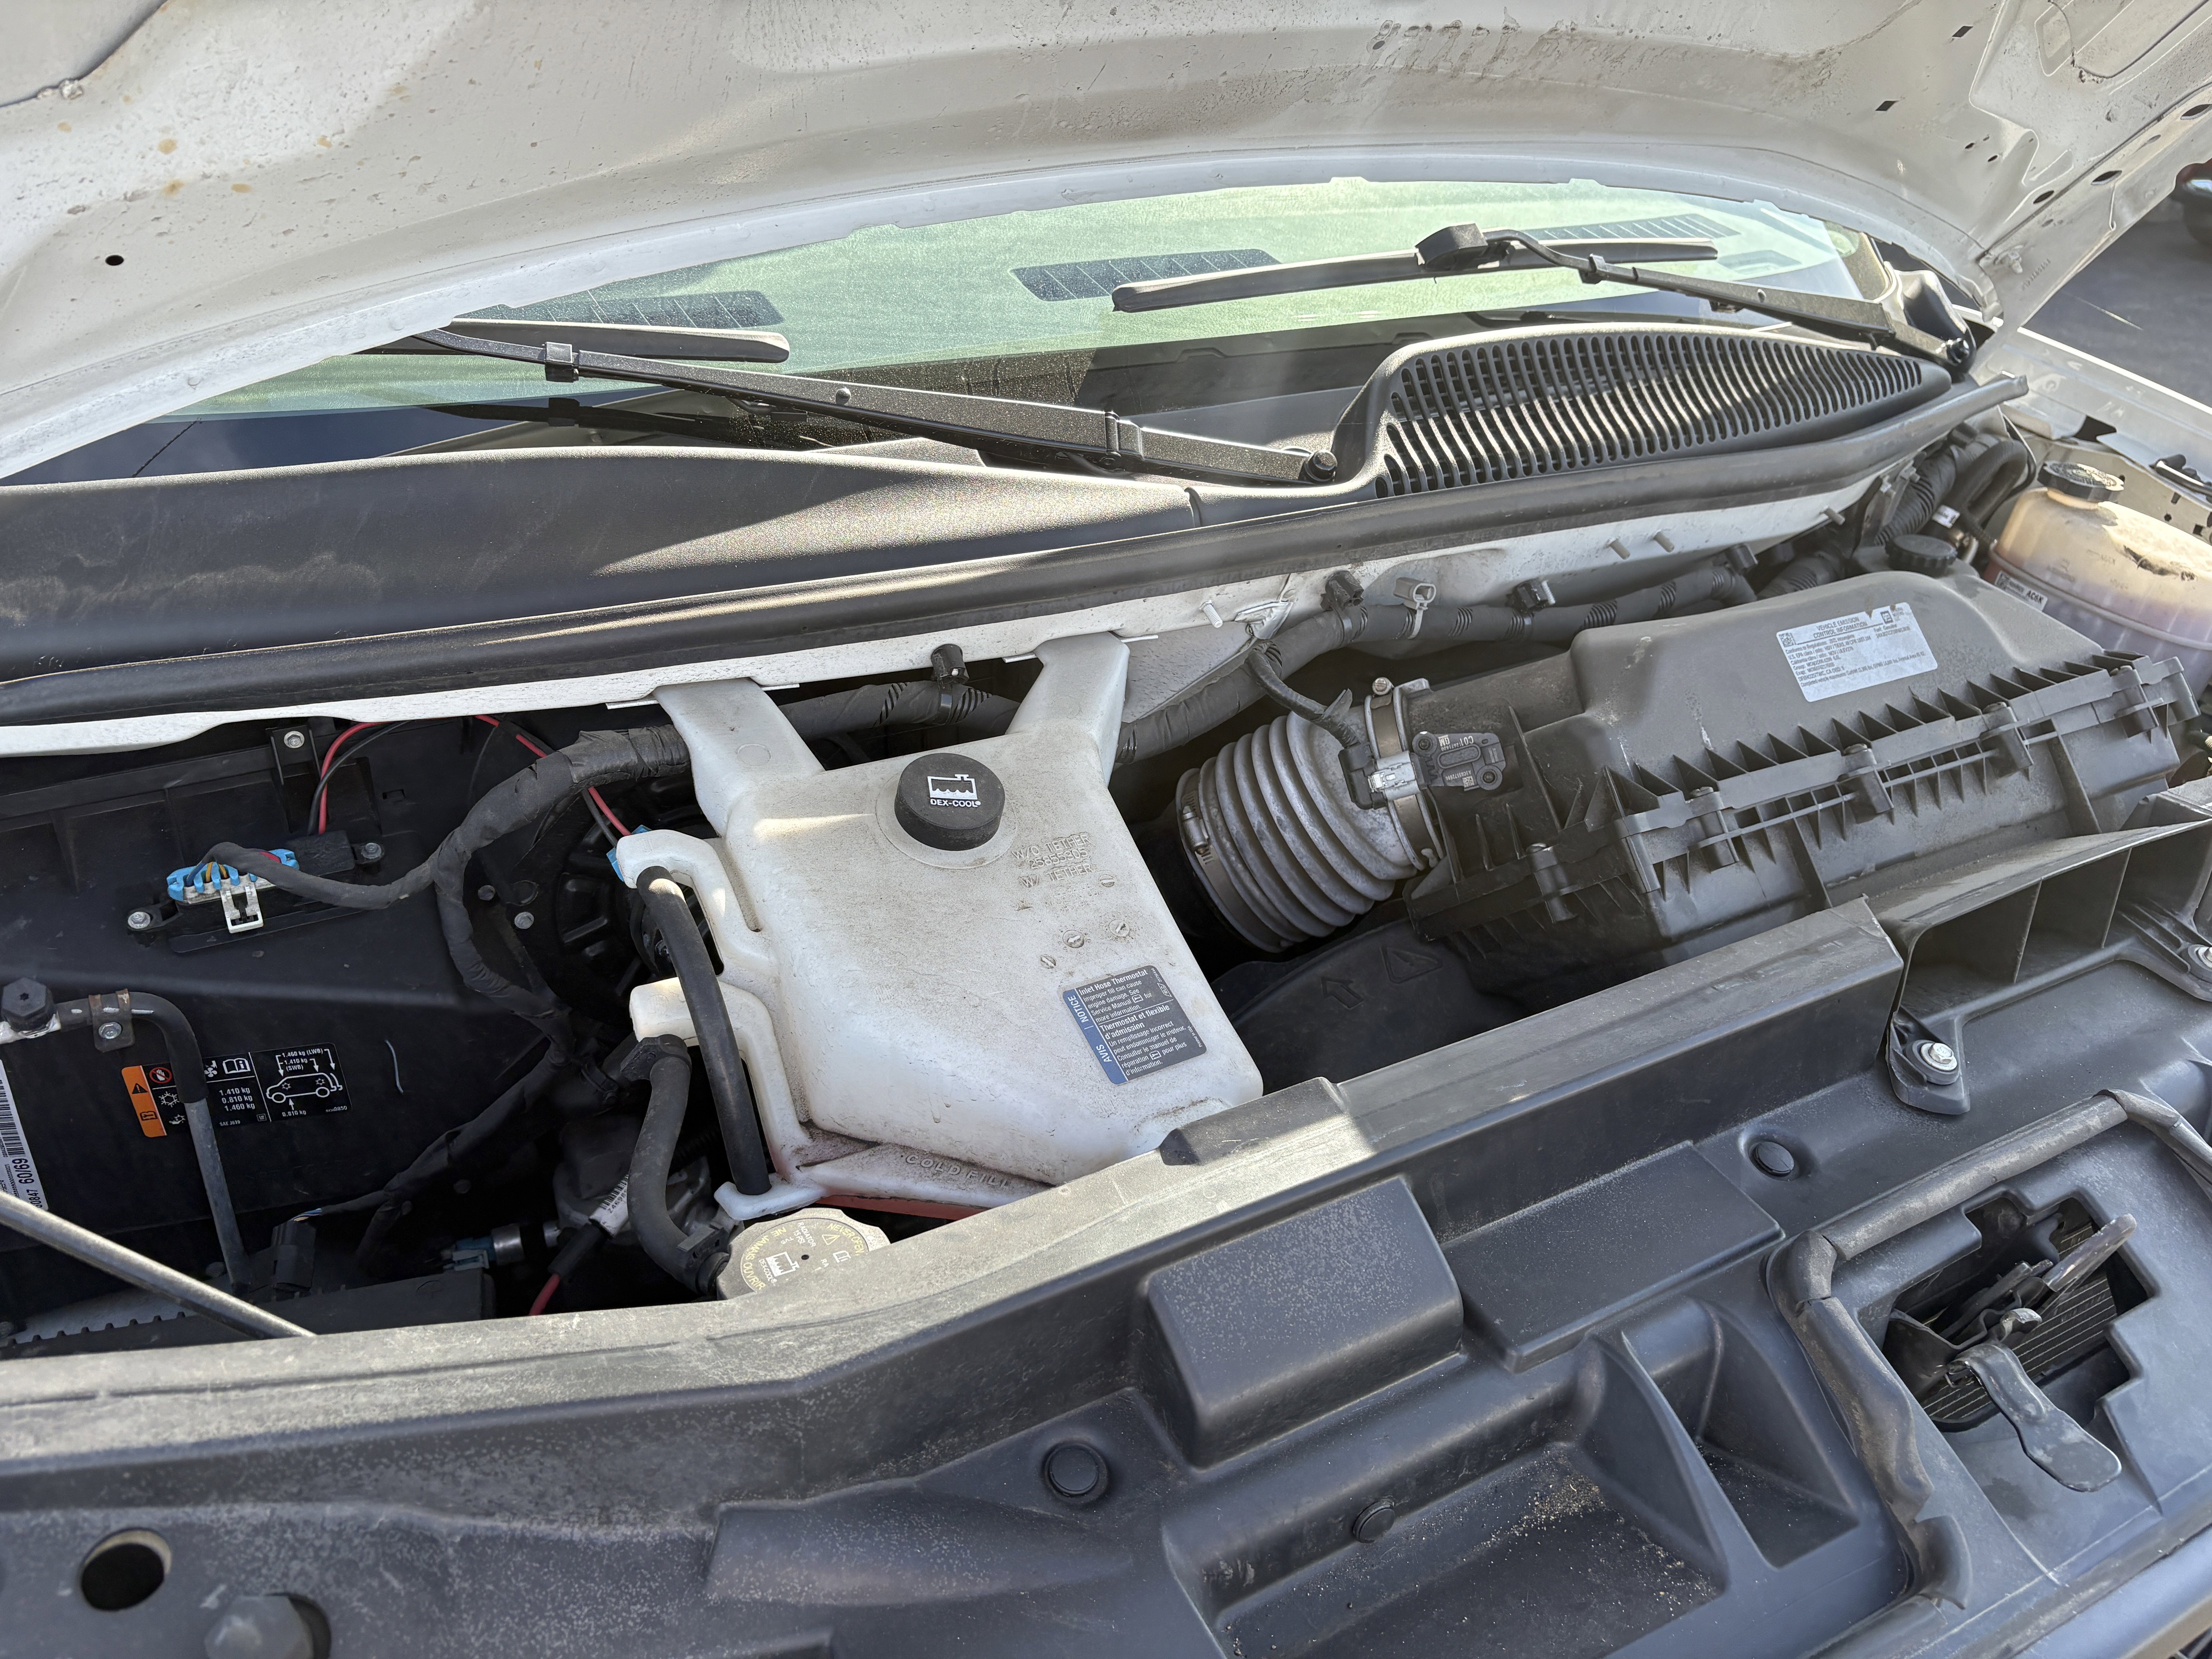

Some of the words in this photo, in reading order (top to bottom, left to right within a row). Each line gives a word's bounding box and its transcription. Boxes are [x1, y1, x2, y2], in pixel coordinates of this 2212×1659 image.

[1812, 629, 1837, 639] CONTROL
[1836, 621, 1868, 633] INFORMATION
[1816, 622, 1838, 631] VEHICLE
[1439, 738, 1450, 746] GM
[1011, 846, 1040, 860] W/O
[1045, 834, 1092, 852] TETHER
[1027, 848, 1088, 869] 25855305
[1021, 875, 1039, 888] W/
[1046, 863, 1092, 881] TETHER
[1078, 985, 1096, 996] Inlet
[1094, 981, 1112, 990] Hose
[1111, 969, 1148, 985] Thermostat
[1082, 990, 1108, 1003] Improper
[1126, 980, 1142, 988] cause
[1066, 994, 1090, 1023] NOTICE
[1087, 999, 1106, 1010] engine
[1105, 991, 1130, 1003] damage.
[1091, 1005, 1112, 1016] Service
[1111, 998, 1132, 1009] Manual
[1095, 1015, 1110, 1023] more
[1109, 1003, 1142, 1018] information.
[1099, 1014, 1138, 1032] Thermostat
[1145, 1004, 1170, 1017] flexible
[1103, 1020, 1145, 1040] d'admission
[1113, 1046, 1127, 1055] peut
[1125, 1034, 1161, 1051] endommager
[1165, 1025, 1186, 1036] moteur.
[1117, 1029, 1151, 1045] remplissage
[1149, 1020, 1174, 1033] incorrect
[1095, 1044, 1113, 1063] AVIS
[1116, 1047, 1143, 1062] Consulter
[1148, 1039, 1170, 1050] manuel
[1121, 1054, 1150, 1070] réparation
[1161, 1046, 1175, 1055] pour
[1174, 1041, 1187, 1050] plus
[1124, 1057, 1163, 1077] d'information.
[218, 1087, 240, 1096] 1.410
[221, 1095, 242, 1104] 0.810
[224, 1103, 245, 1111] 1.460
[246, 1102, 256, 1110] kg
[12, 1158, 35, 1184] 60/69
[906, 1154, 961, 1175] COLD
[966, 1170, 1013, 1191] FILL
[771, 1226, 787, 1238] NE
[797, 1222, 817, 1248] RADIATOR
[827, 1223, 852, 1237] NEVER
[850, 1236, 865, 1255] OPEN
[745, 1236, 769, 1261] JAMAIS
[743, 1263, 766, 1291] OUVRIR
